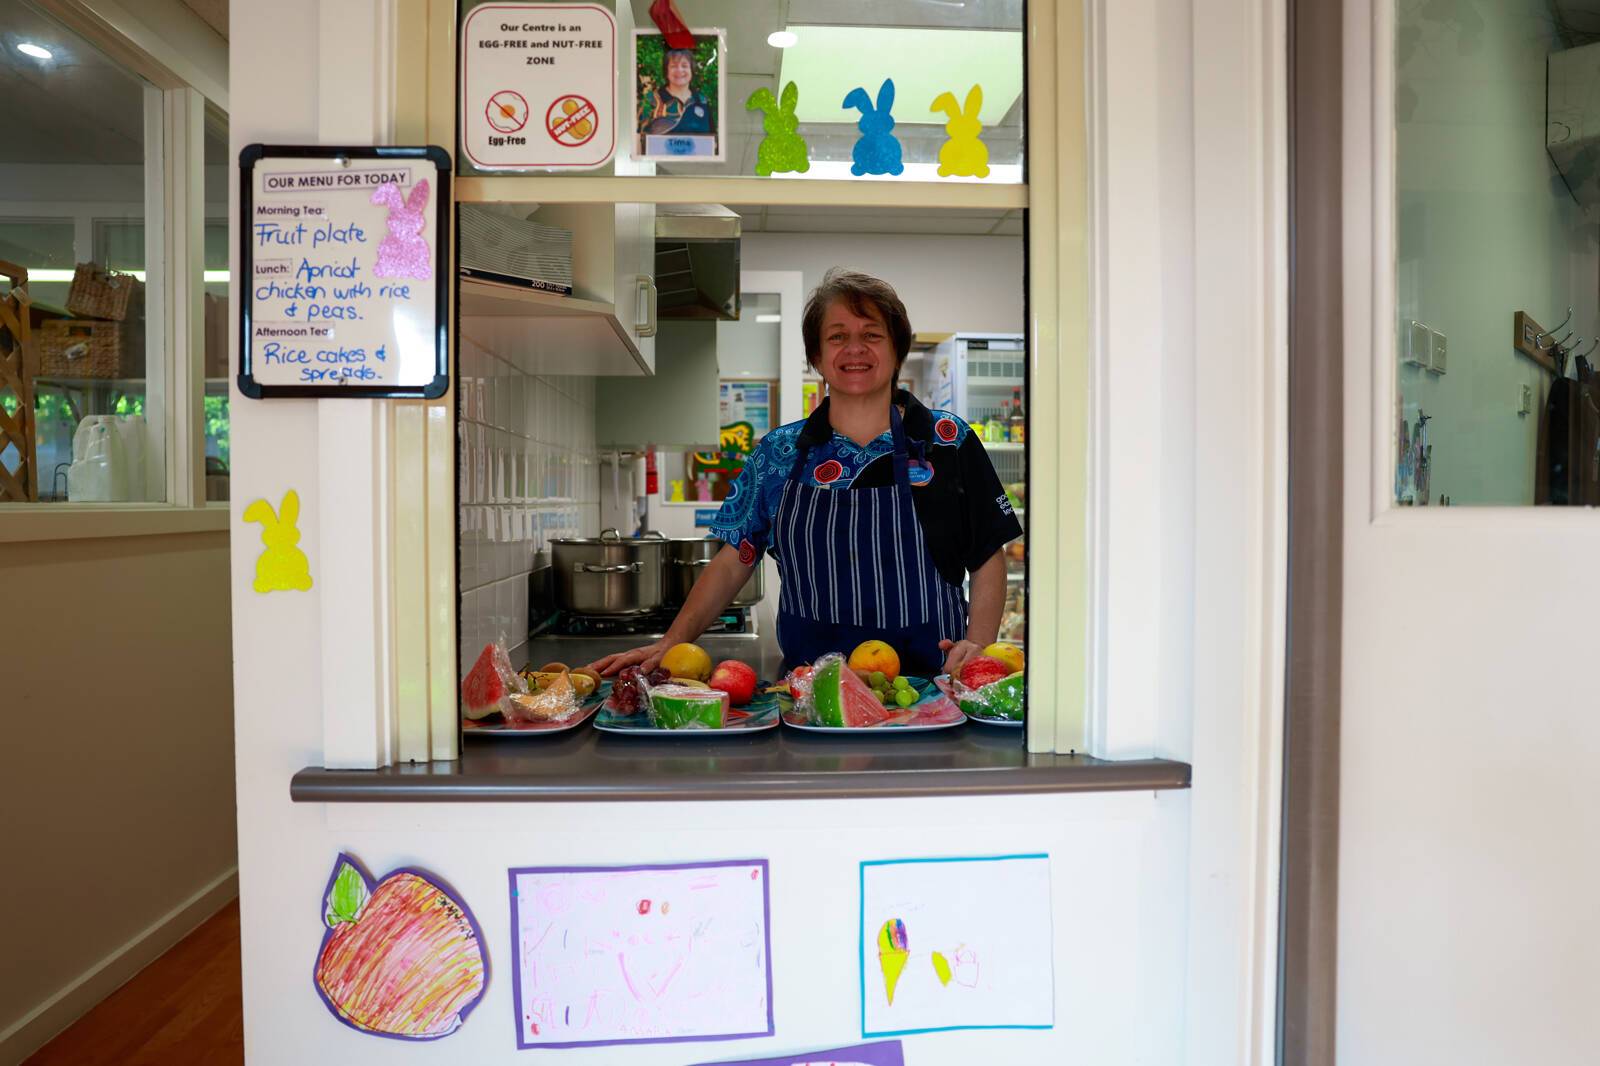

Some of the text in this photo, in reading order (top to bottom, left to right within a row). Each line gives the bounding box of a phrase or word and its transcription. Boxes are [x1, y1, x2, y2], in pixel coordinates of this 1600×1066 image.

[500, 23, 581, 32] Our Centre is an
[479, 40, 603, 48] EGG-FREE and NUT-FREE
[526, 56, 555, 65] ZONE
[488, 136, 526, 146] Egg-Free
[268, 173, 406, 188] OUR MENU FOR TODAY
[257, 206, 325, 217] Morning Tea:
[254, 222, 367, 248] Fruit plate
[255, 264, 290, 274] Lunch:
[296, 257, 360, 283] Apricot
[255, 281, 411, 301] chicken with rice
[307, 303, 363, 322] peas.
[255, 327, 307, 336] Afternoon
[263, 342, 311, 365] Rice
[316, 347, 367, 364] cakes
[300, 364, 383, 382] spreads.
